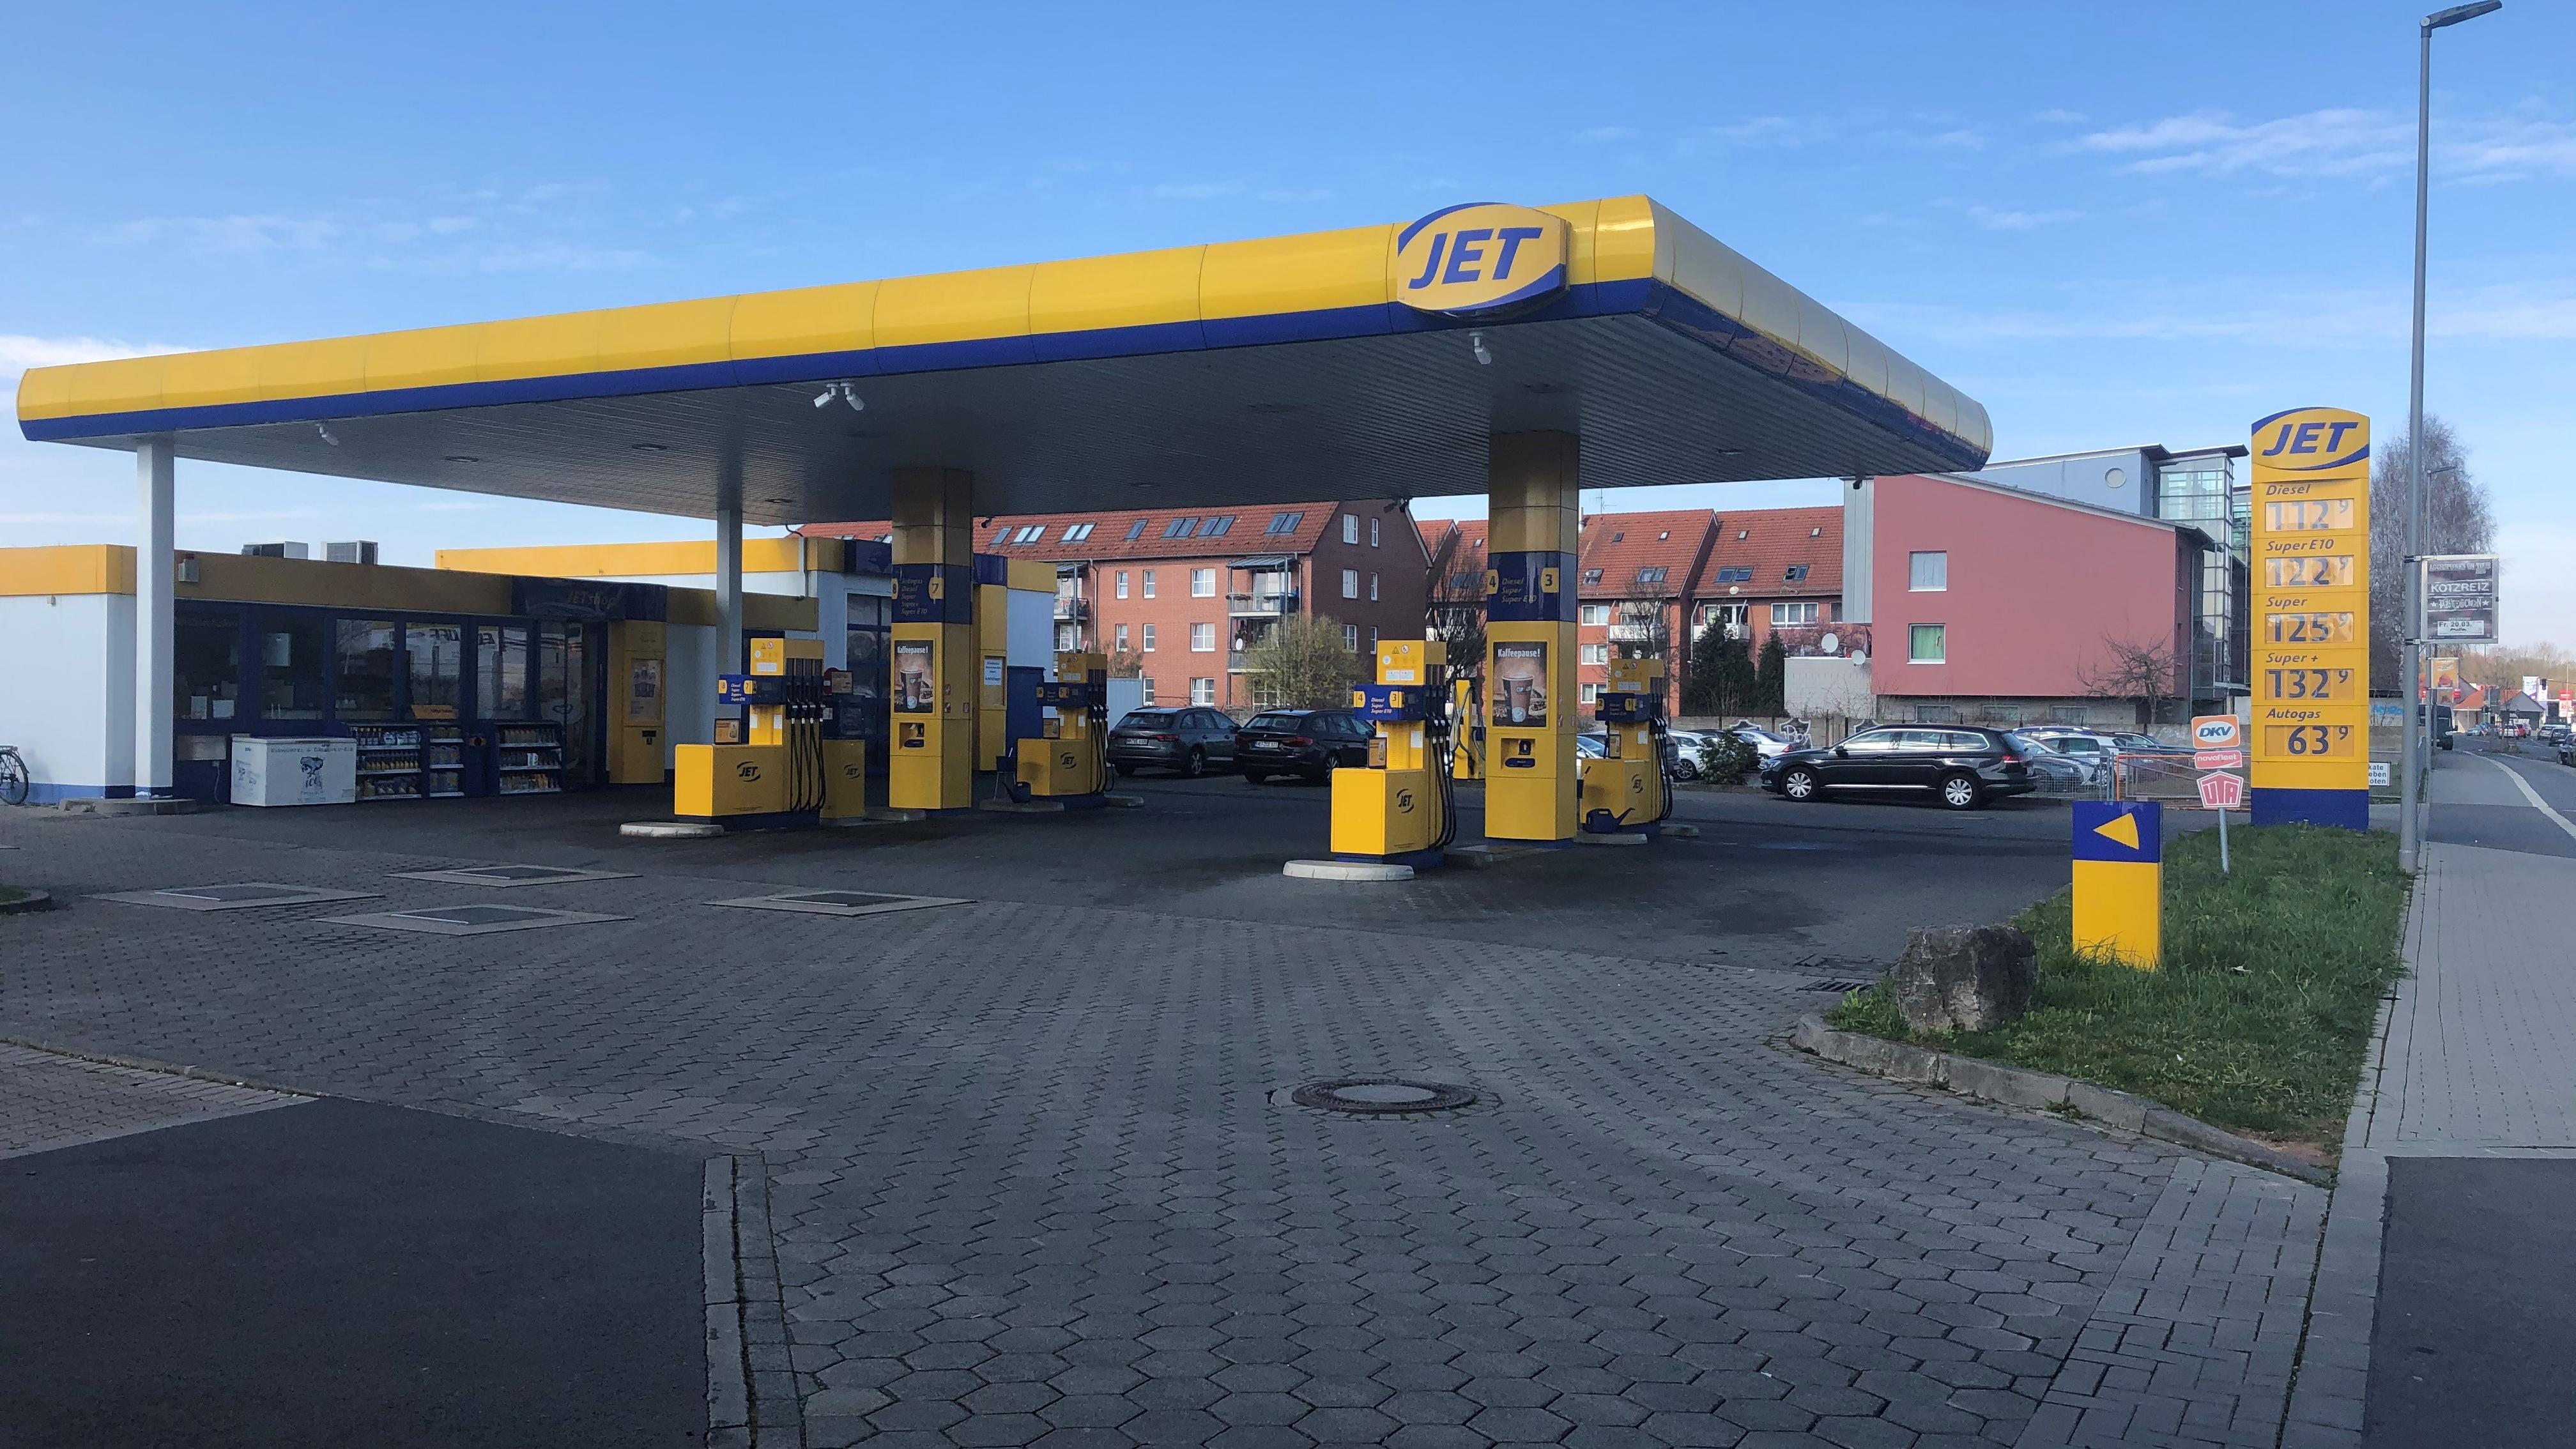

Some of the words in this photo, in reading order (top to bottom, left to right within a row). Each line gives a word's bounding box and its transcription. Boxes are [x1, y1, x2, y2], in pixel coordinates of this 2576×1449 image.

[1407, 226, 1544, 289] JET
[2261, 422, 2359, 456] JET
[2266, 484, 2311, 496] Diesel
[2268, 500, 2330, 530] 112
[2338, 499, 2350, 514] 9
[2266, 540, 2308, 555] Super
[2309, 539, 2334, 549] E10
[2268, 557, 2330, 586] 122
[1489, 576, 1496, 588] 4
[1545, 574, 1553, 586] 3
[892, 583, 897, 594] 8
[931, 583, 939, 594] 7
[1502, 587, 1522, 595] Super
[2430, 582, 2490, 593] KOTZREIZ
[1502, 595, 1522, 604] Super
[2266, 596, 2308, 610] Super
[2268, 613, 2330, 642] 125
[2338, 612, 2349, 628] 9
[1498, 648, 1540, 659] Kaffeepause!
[2266, 652, 2308, 666] Super
[2268, 669, 2330, 698] 132
[2338, 669, 2349, 684] 9
[1358, 693, 1363, 702] 4
[1392, 693, 1397, 702] 3
[2266, 708, 2321, 722] Autogas
[2198, 726, 2232, 737] DKV
[2287, 726, 2329, 755] 63
[2338, 726, 2349, 740] 9
[1062, 756, 1075, 765] JET
[739, 766, 758, 778] JET
[847, 767, 858, 776] JET
[2201, 774, 2241, 804] UTA
[1398, 794, 1413, 808] JET
